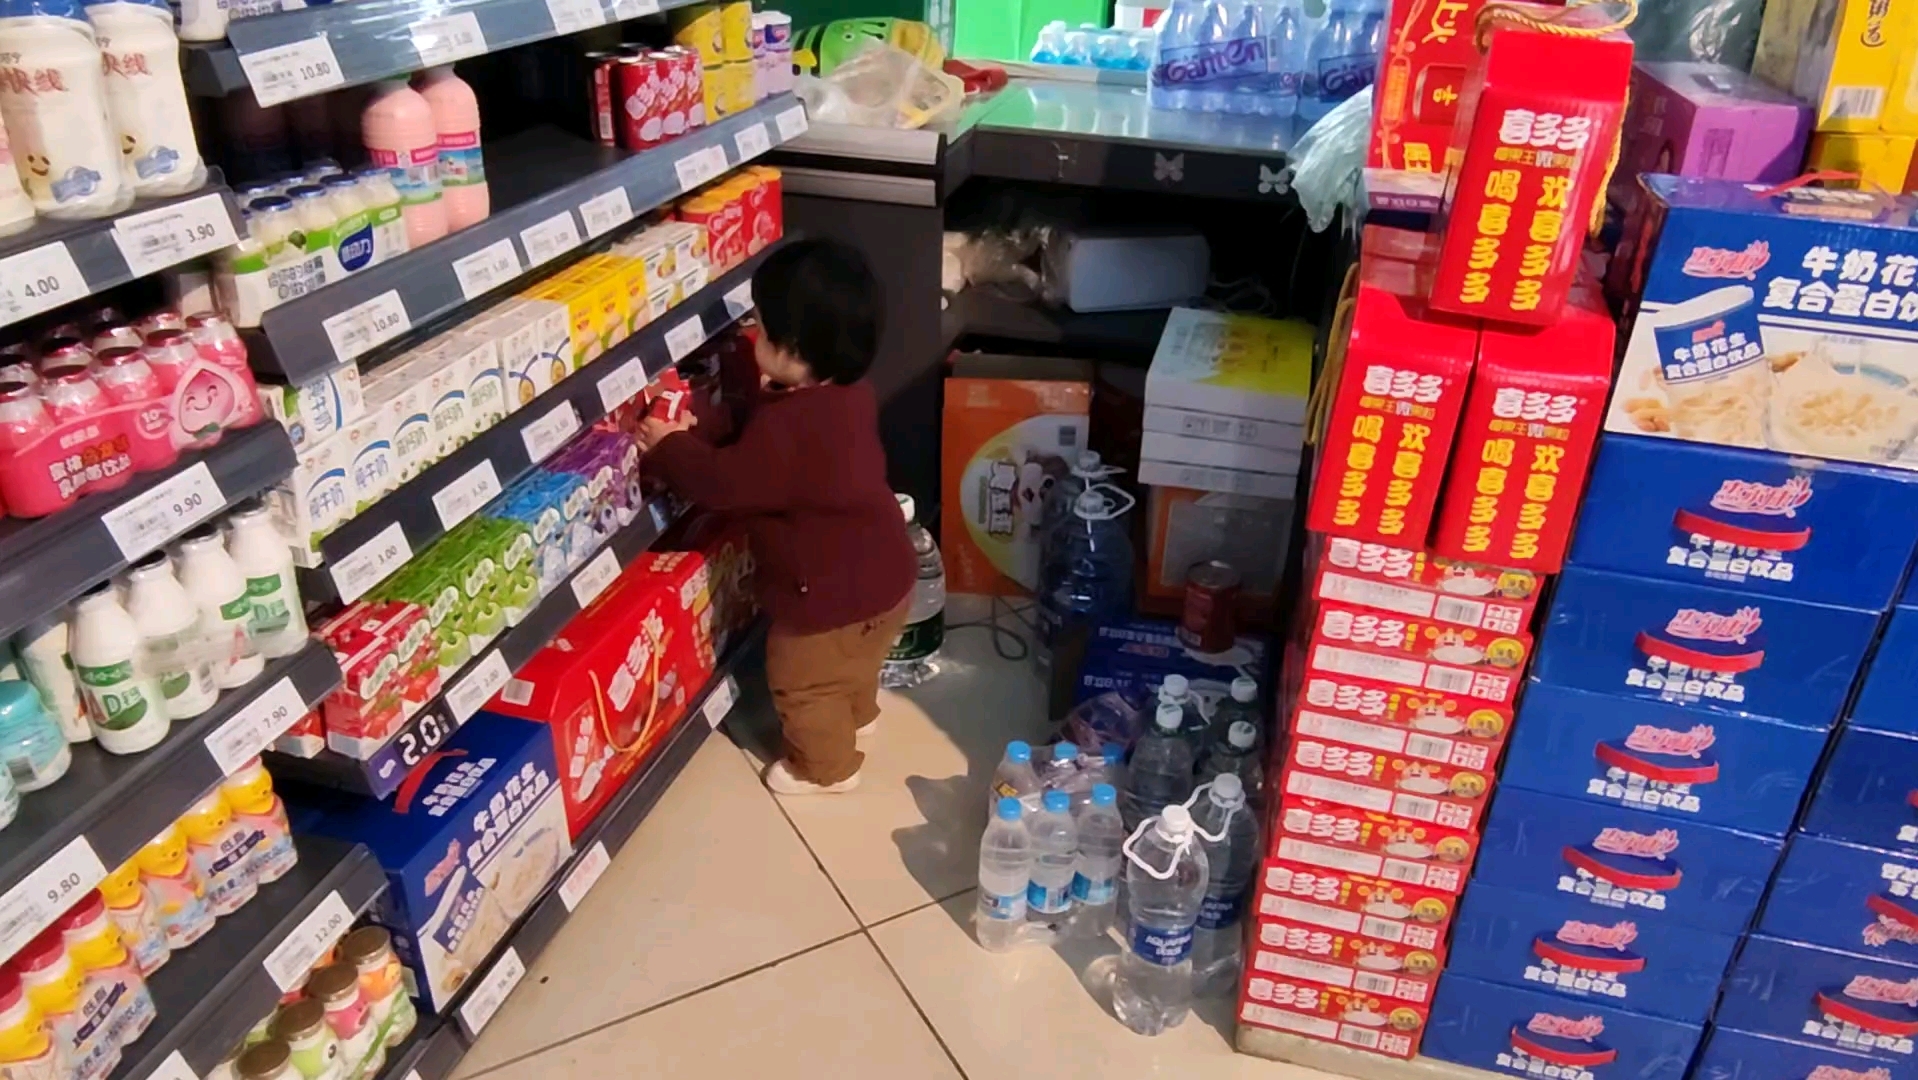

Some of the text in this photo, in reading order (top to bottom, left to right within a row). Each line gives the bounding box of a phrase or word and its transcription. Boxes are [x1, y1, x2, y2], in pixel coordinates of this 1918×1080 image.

[299, 61, 332, 80] 10.80
[1499, 108, 1591, 151] 喜多多
[186, 223, 216, 243] 3.90
[24, 275, 60, 298] 4.00
[1673, 332, 1748, 362] 牛奶花生
[1362, 365, 1443, 404] 喜多多
[1492, 387, 1577, 424] 喜多多
[173, 492, 202, 517] 9.90
[1328, 537, 1414, 578] 喜多多
[1321, 610, 1405, 648] 喜多多
[1306, 678, 1387, 716] 喜多多
[263, 706, 288, 729] 7.90
[1295, 741, 1374, 776] 喜多多
[1283, 808, 1360, 842] 喜多多
[47, 871, 81, 903] 9.80
[1265, 867, 1340, 901] 喜多多
[313, 913, 343, 944] 12.00
[1260, 923, 1333, 955] 喜多多
[1248, 977, 1319, 1009] 喜多多
